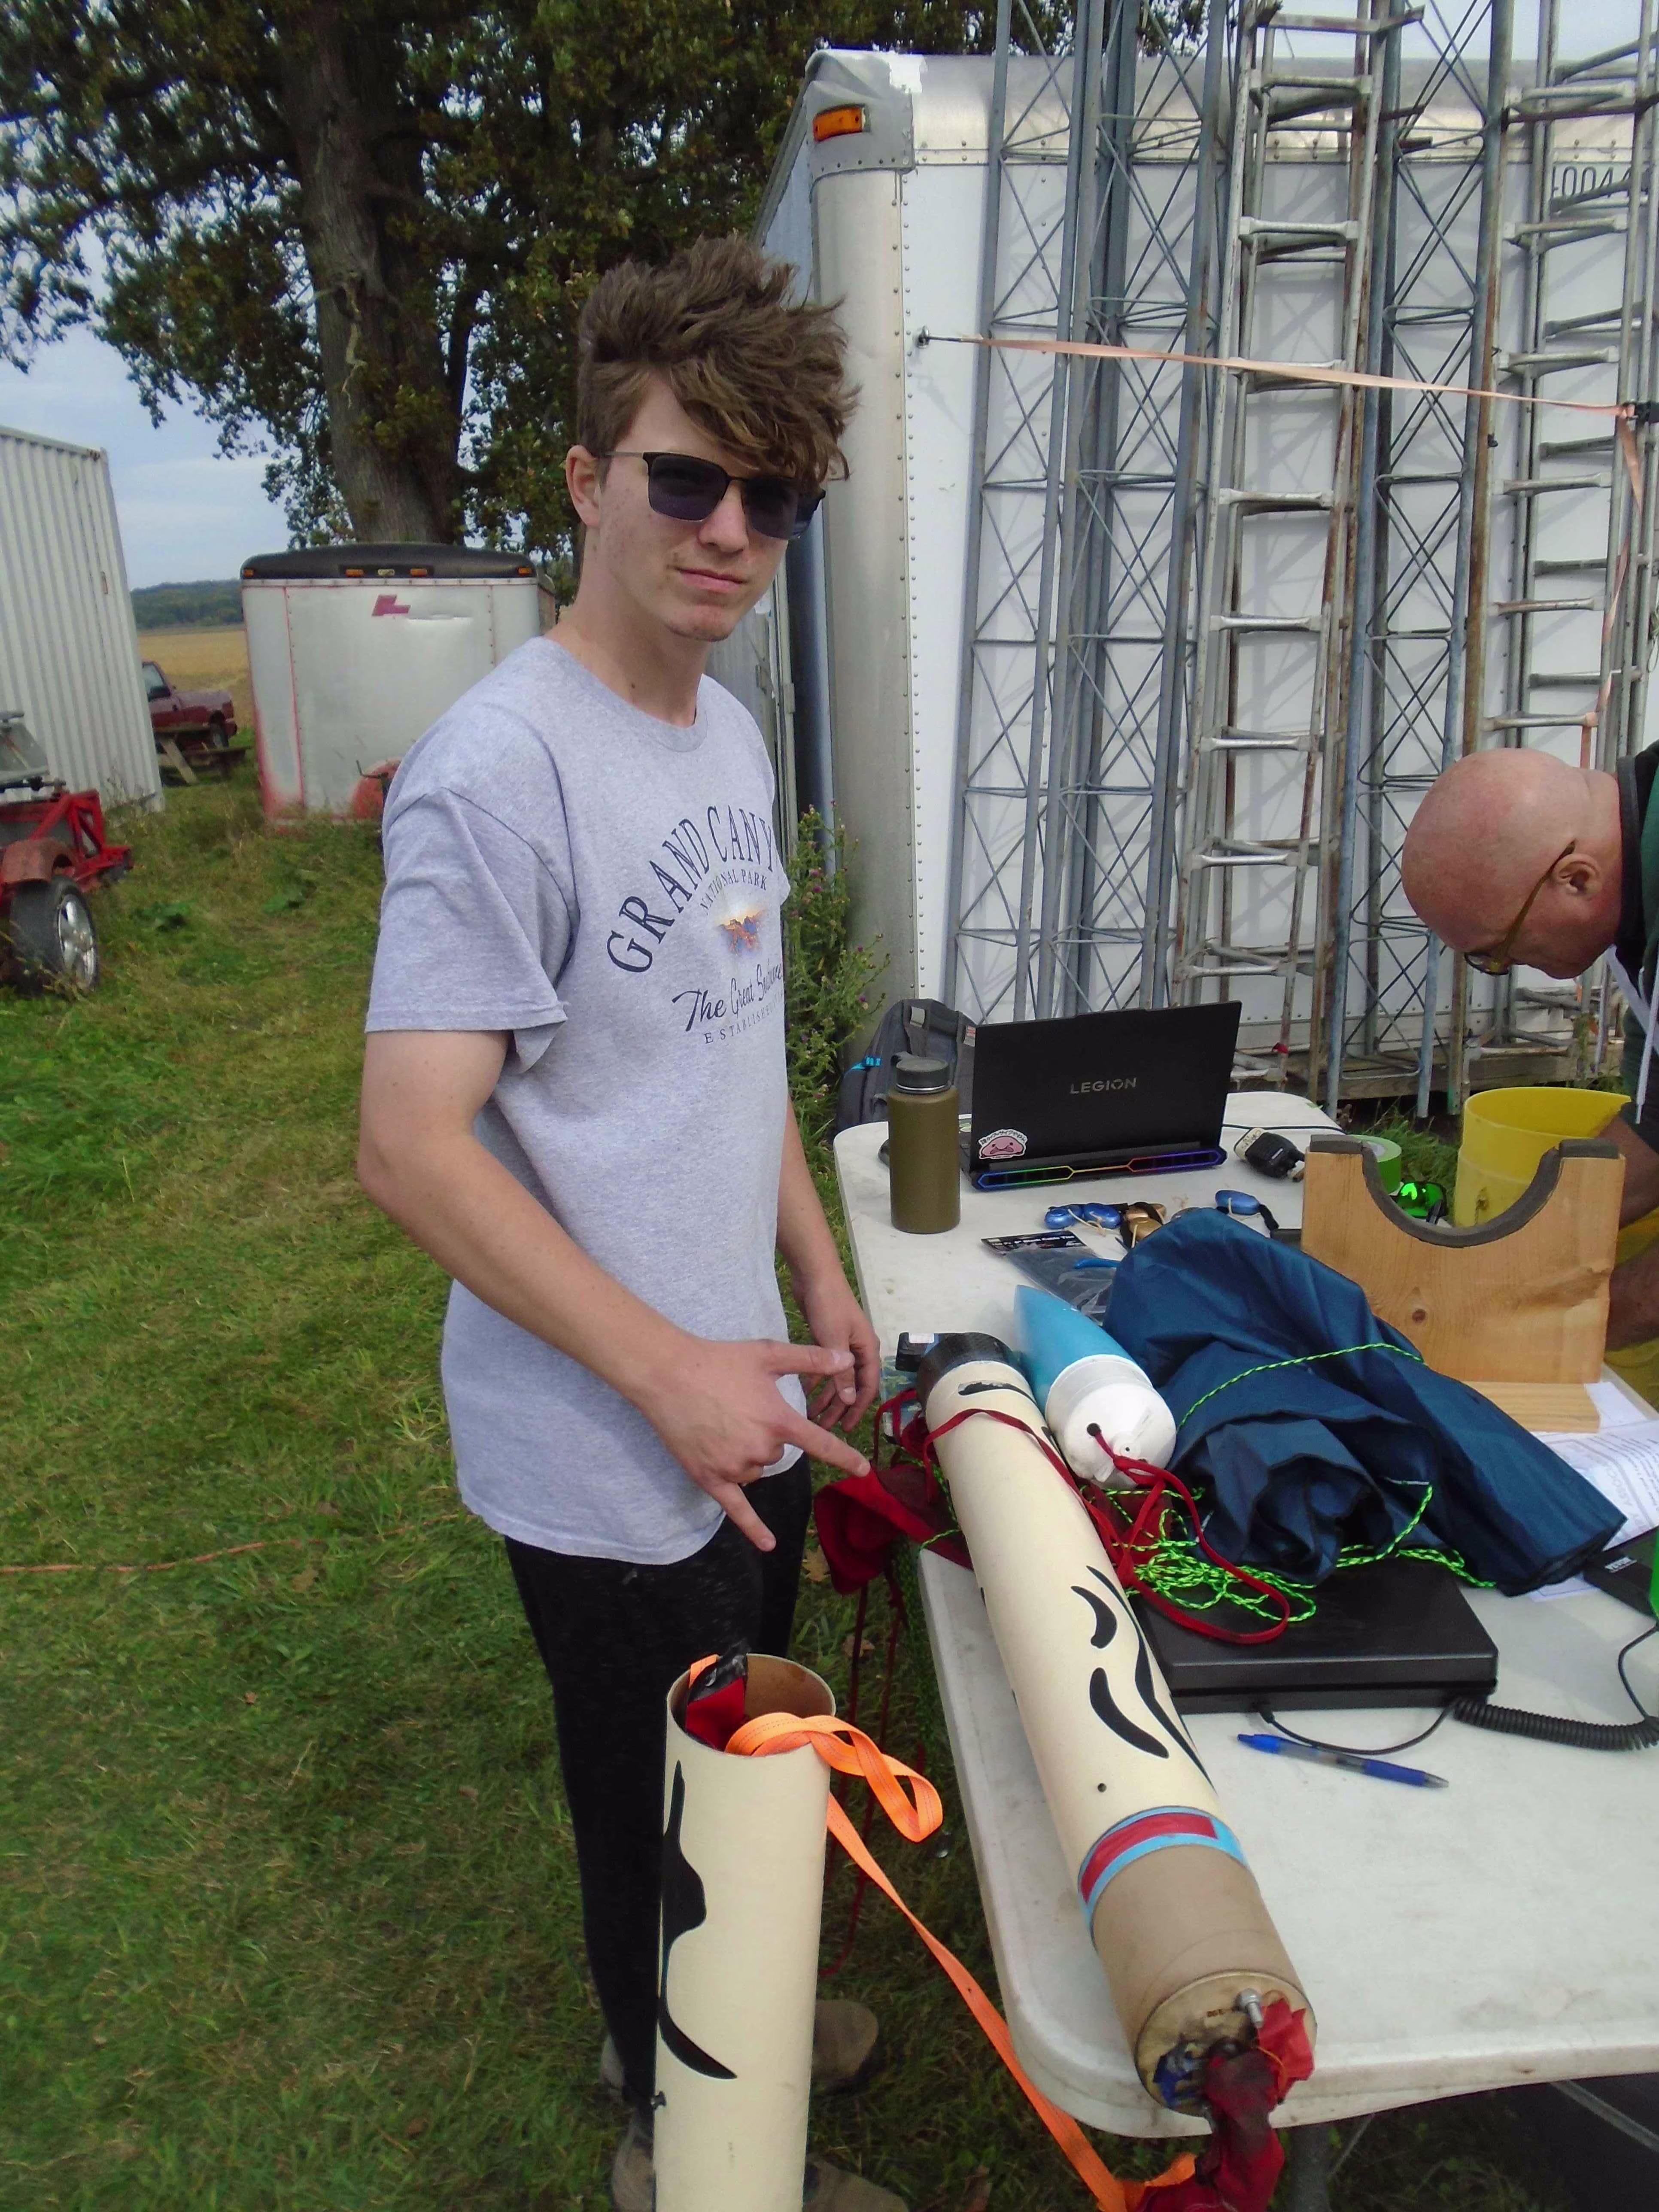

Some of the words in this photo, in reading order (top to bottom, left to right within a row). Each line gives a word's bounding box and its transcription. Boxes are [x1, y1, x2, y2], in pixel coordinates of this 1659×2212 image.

[607, 819, 710, 973] GRAND
[700, 869, 738, 915] NATIONAL
[741, 869, 767, 890] PARK
[672, 989, 727, 1032] The
[731, 978, 754, 1018] Great
[1070, 1077, 1137, 1094] LEGION
